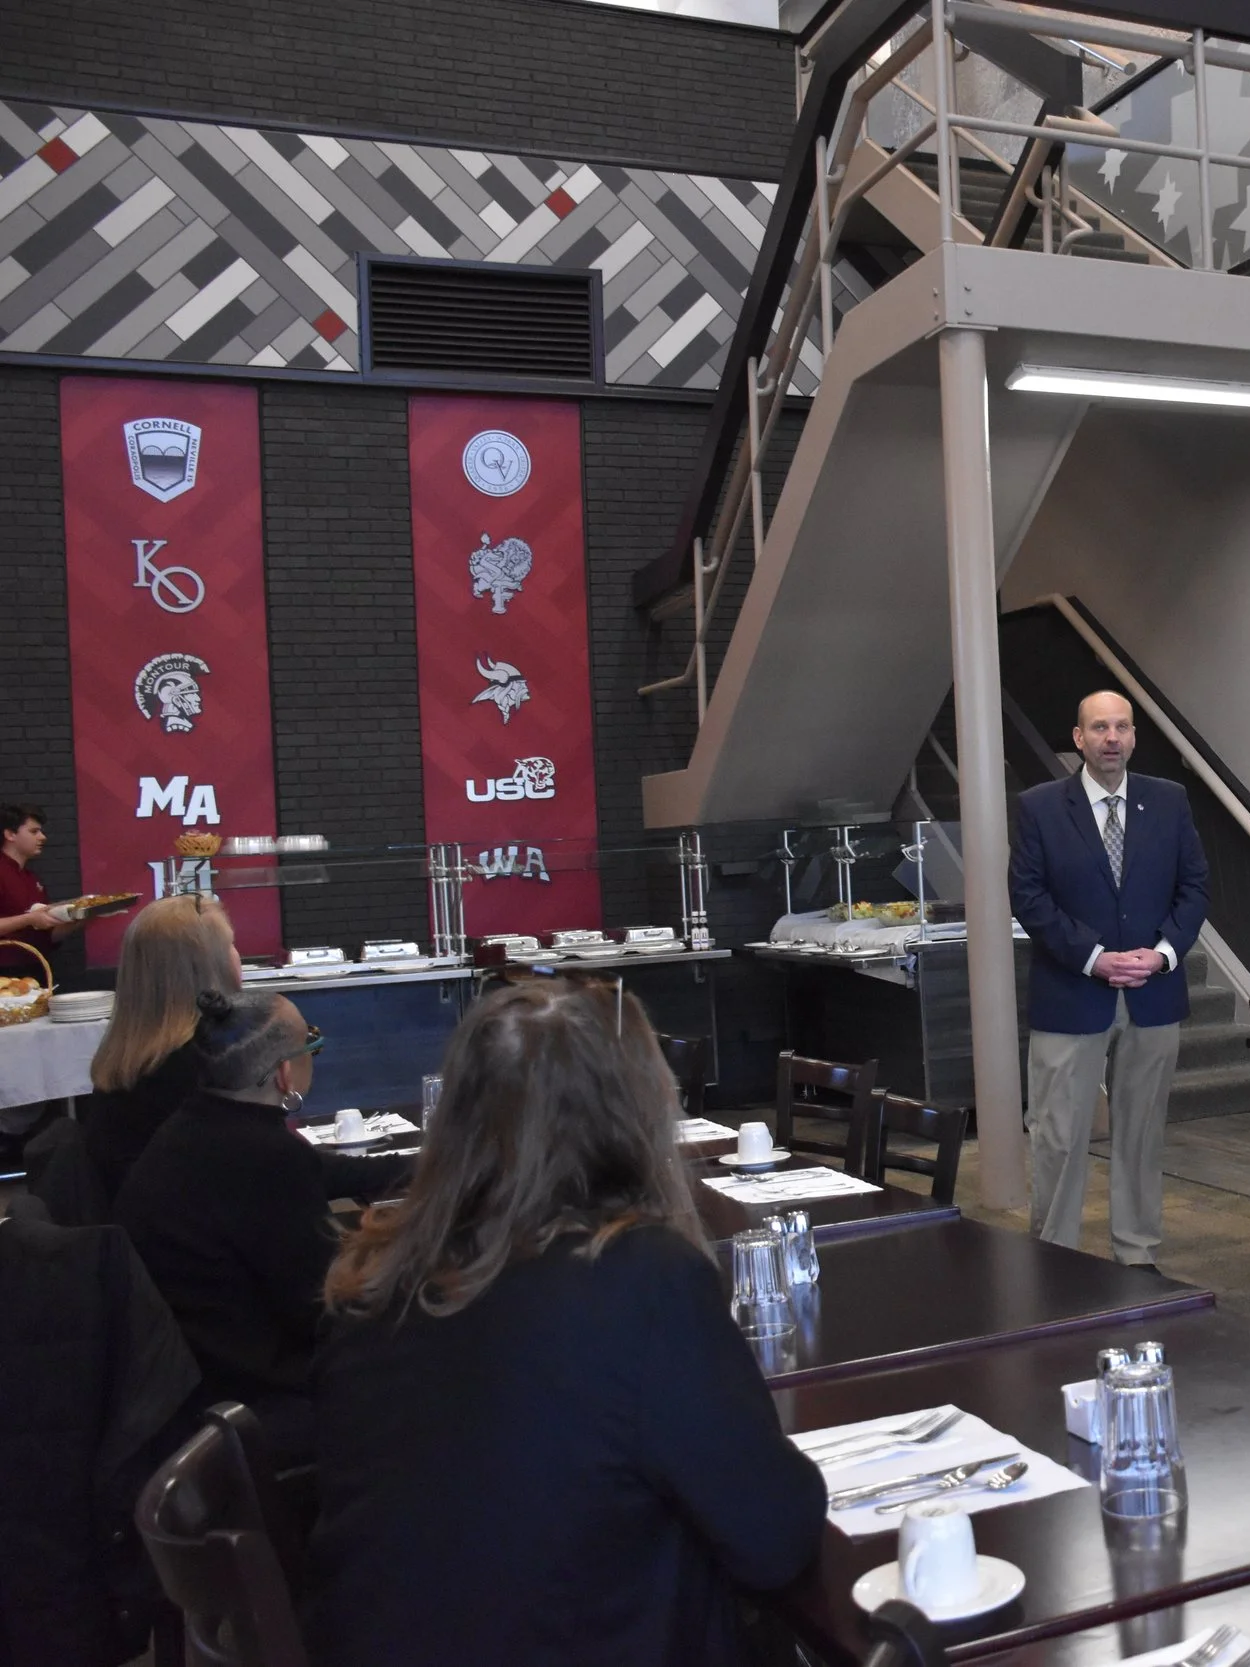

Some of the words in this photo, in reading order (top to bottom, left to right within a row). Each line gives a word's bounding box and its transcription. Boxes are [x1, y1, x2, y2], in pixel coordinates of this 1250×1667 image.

[133, 421, 192, 434] CORNELL
[128, 435, 141, 481] CORAOPOLIS
[187, 438, 198, 474] NEVILLE
[131, 539, 205, 614] KO
[144, 662, 190, 694] MONTOUR
[136, 776, 220, 826] MA
[466, 777, 555, 802] USC
[479, 846, 550, 881] WA
